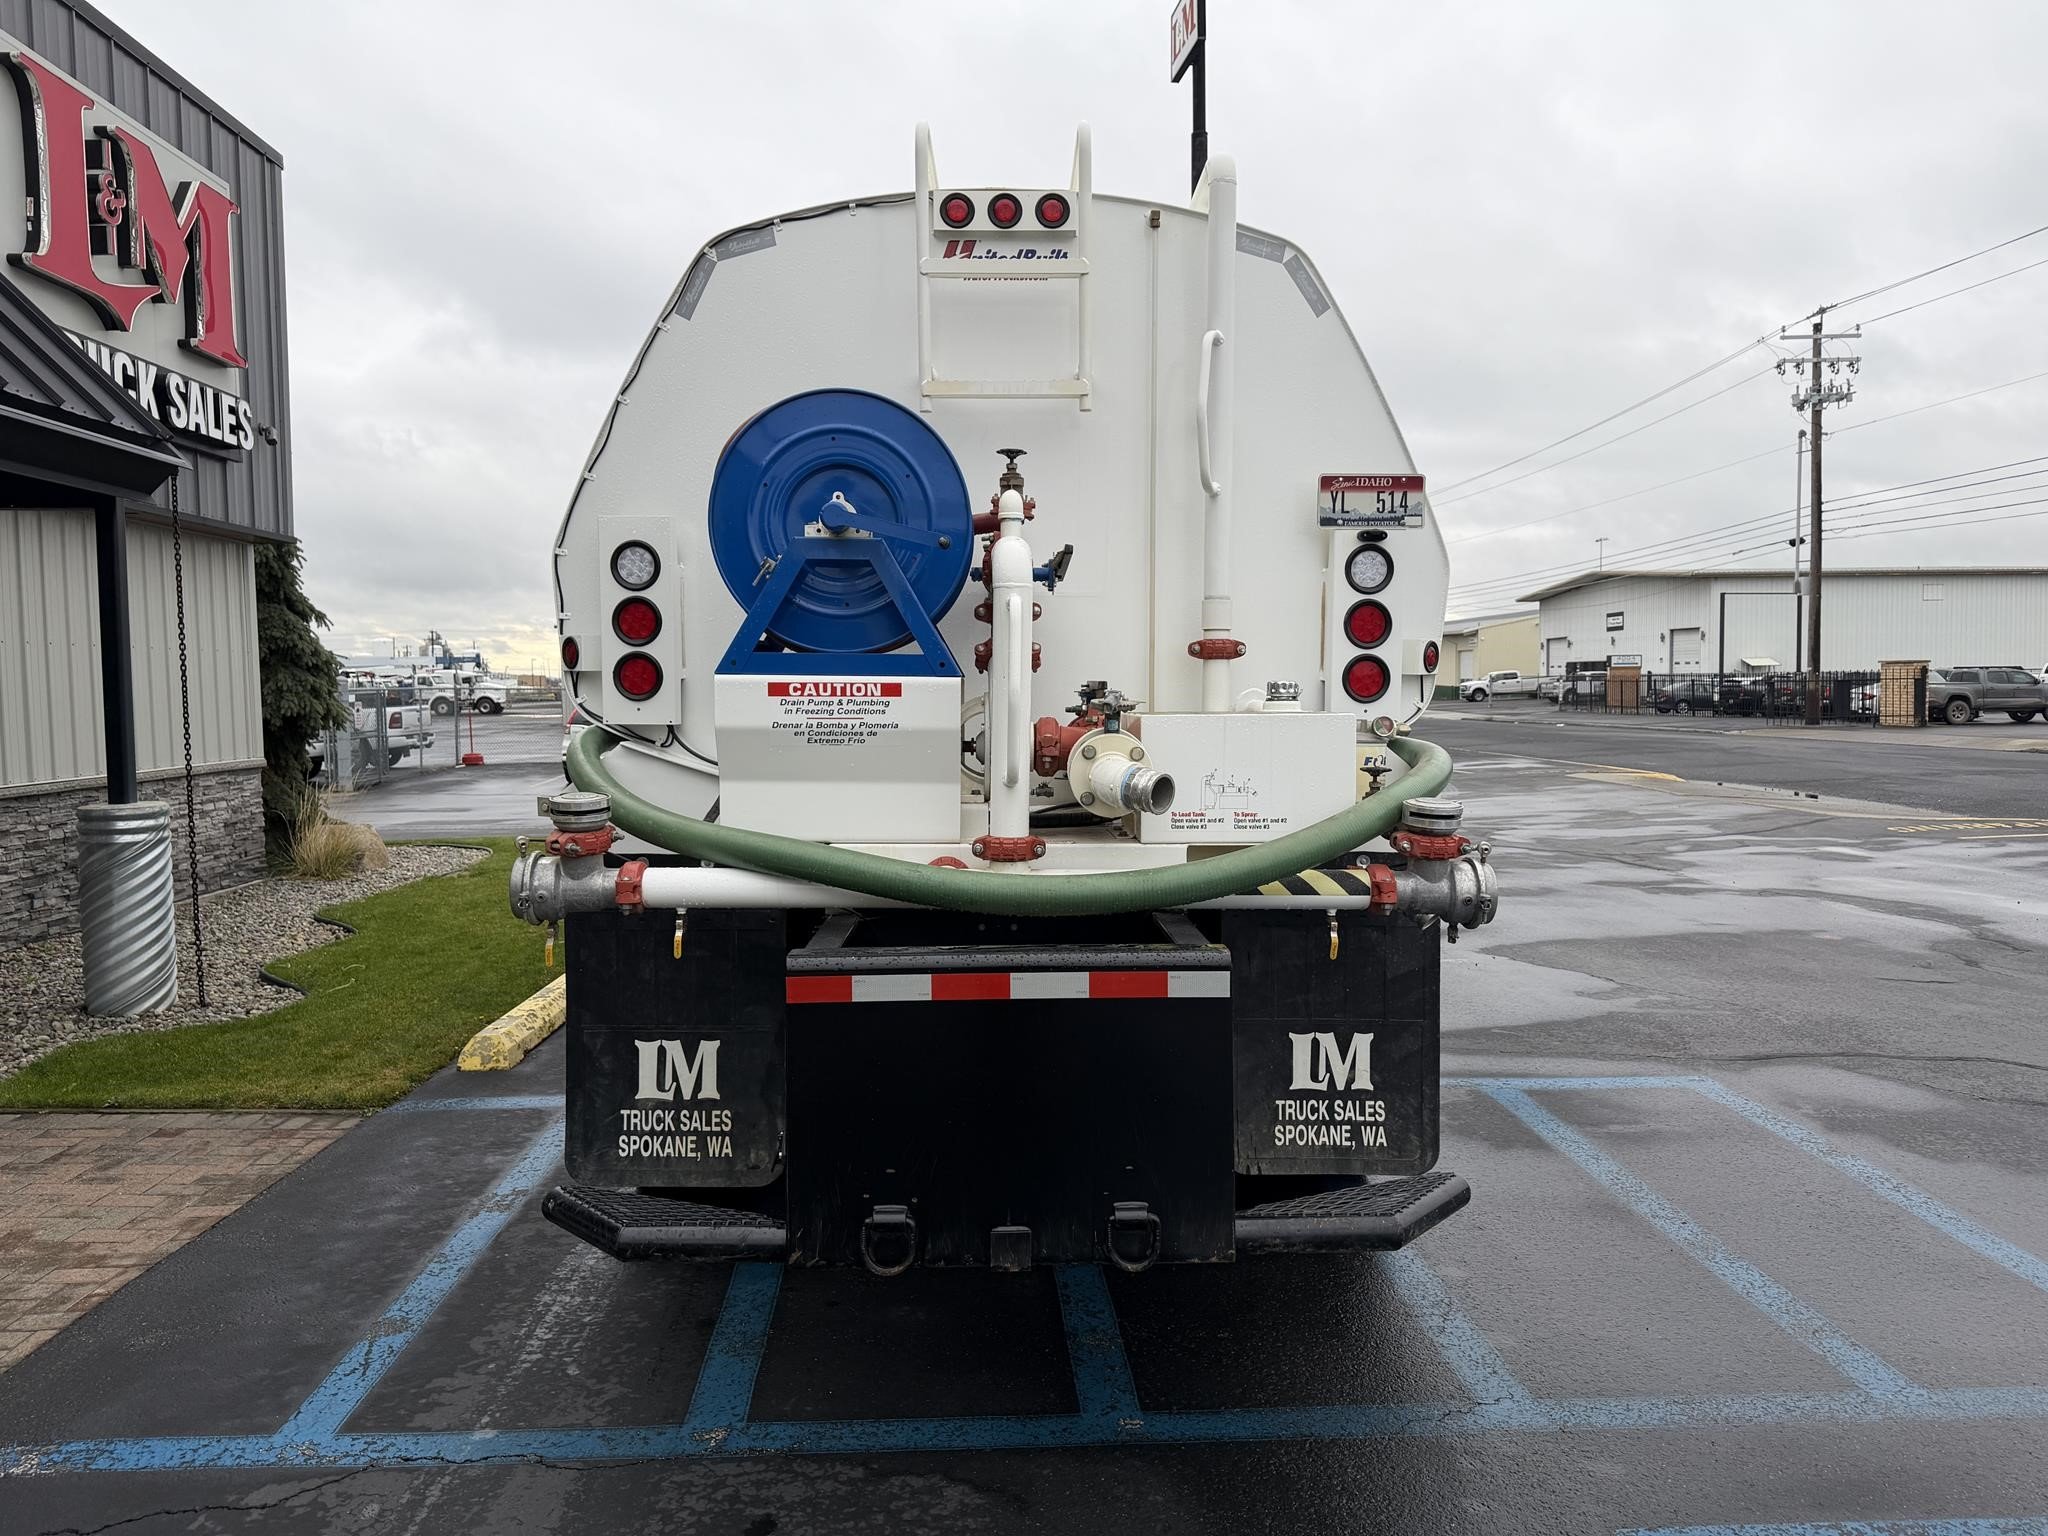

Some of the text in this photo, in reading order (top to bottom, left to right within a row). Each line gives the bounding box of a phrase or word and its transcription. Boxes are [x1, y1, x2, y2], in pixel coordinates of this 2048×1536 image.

[63, 331, 255, 451] UCK SALES
[1355, 477, 1393, 487] IDAHO
[1330, 490, 1409, 514] YL 514
[788, 683, 882, 697] CAUTION
[780, 698, 806, 706] Drain
[807, 698, 834, 708] Pump
[846, 698, 890, 708] Plumbing
[784, 707, 886, 716] in Freezing Conditions
[772, 721, 803, 729] Drenar
[805, 721, 814, 729] la
[816, 721, 848, 729] Bomba
[620, 1109, 732, 1132] TRUCK SALES
[1275, 1099, 1386, 1122] TRUCK SALES
[618, 1134, 733, 1161] SPOKANE, WA
[1274, 1124, 1388, 1150] SPOKANE, WA
